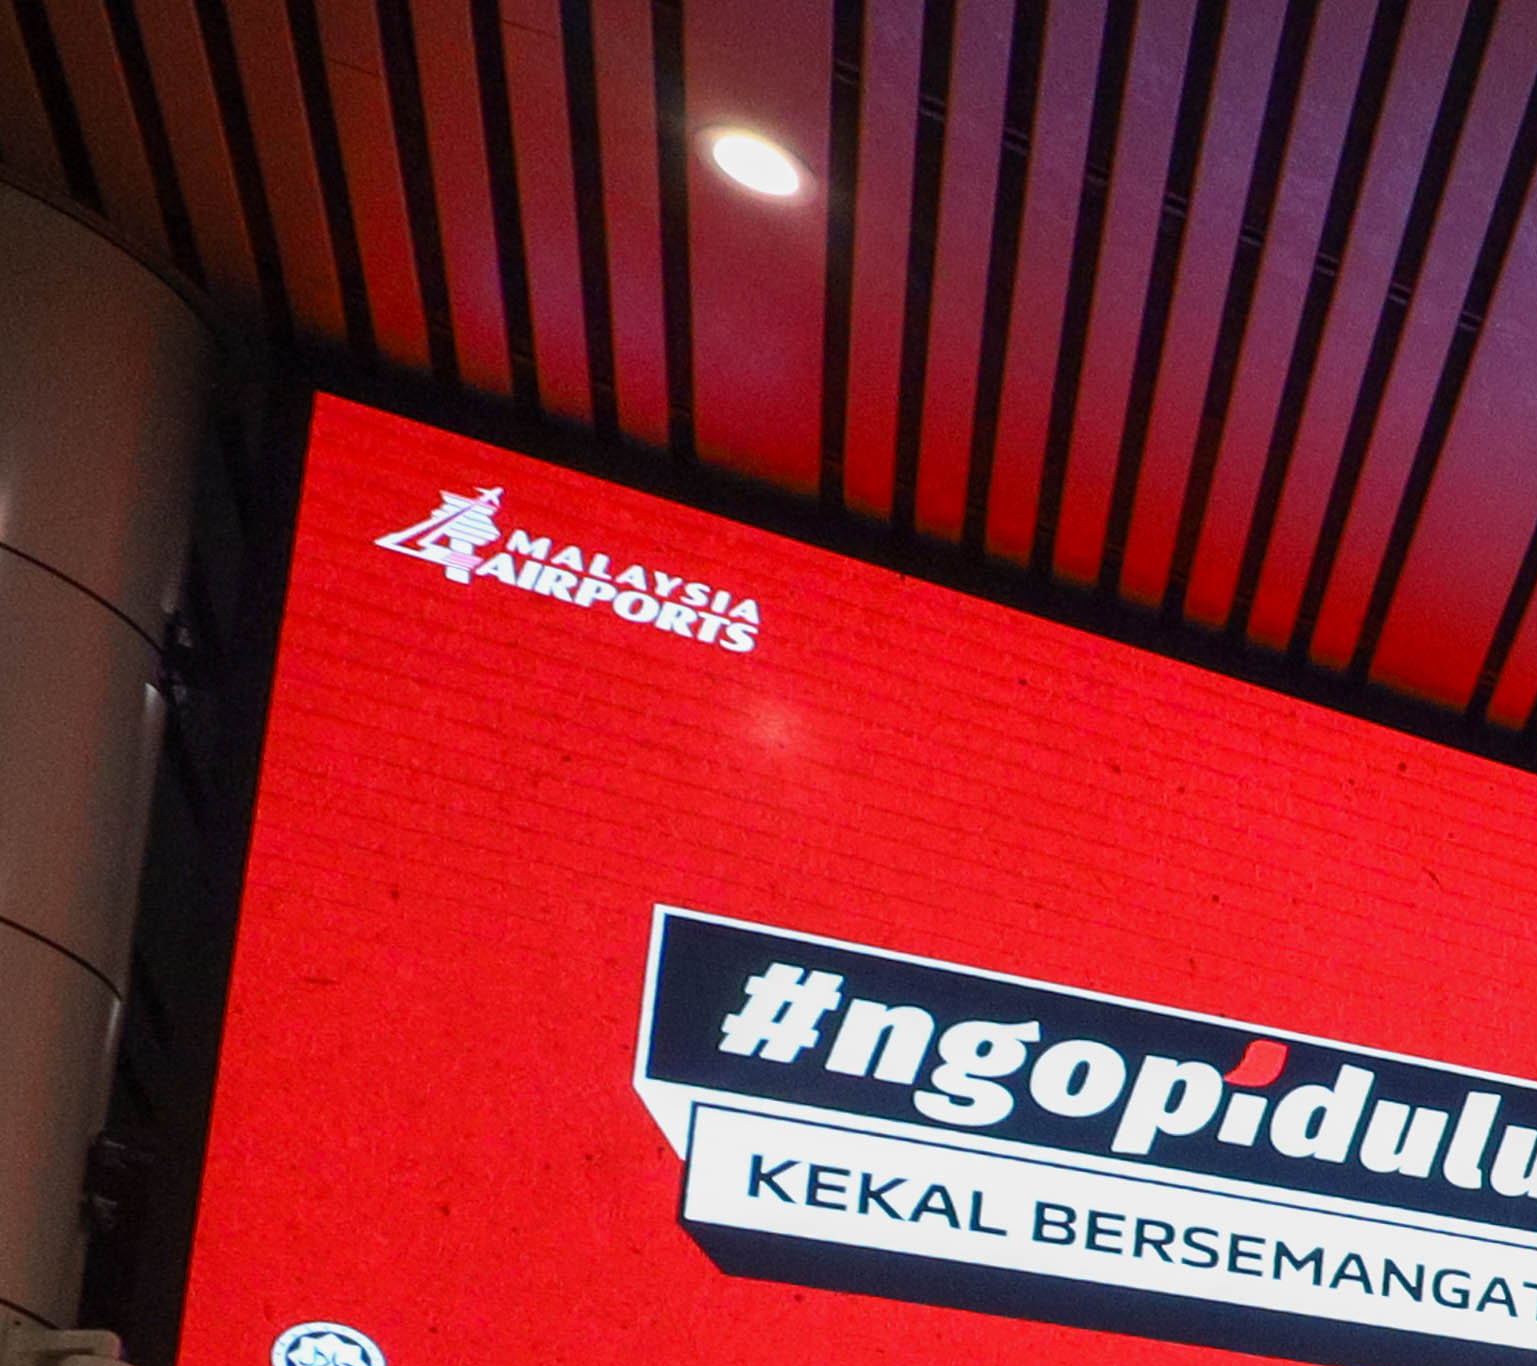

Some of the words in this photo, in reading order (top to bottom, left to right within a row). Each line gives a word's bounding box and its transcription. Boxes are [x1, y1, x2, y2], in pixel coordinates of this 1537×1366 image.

[475, 552, 760, 653] AIRPORTS
[505, 529, 761, 625] MALAYSIA
[745, 1151, 1008, 1238] KEKAL
